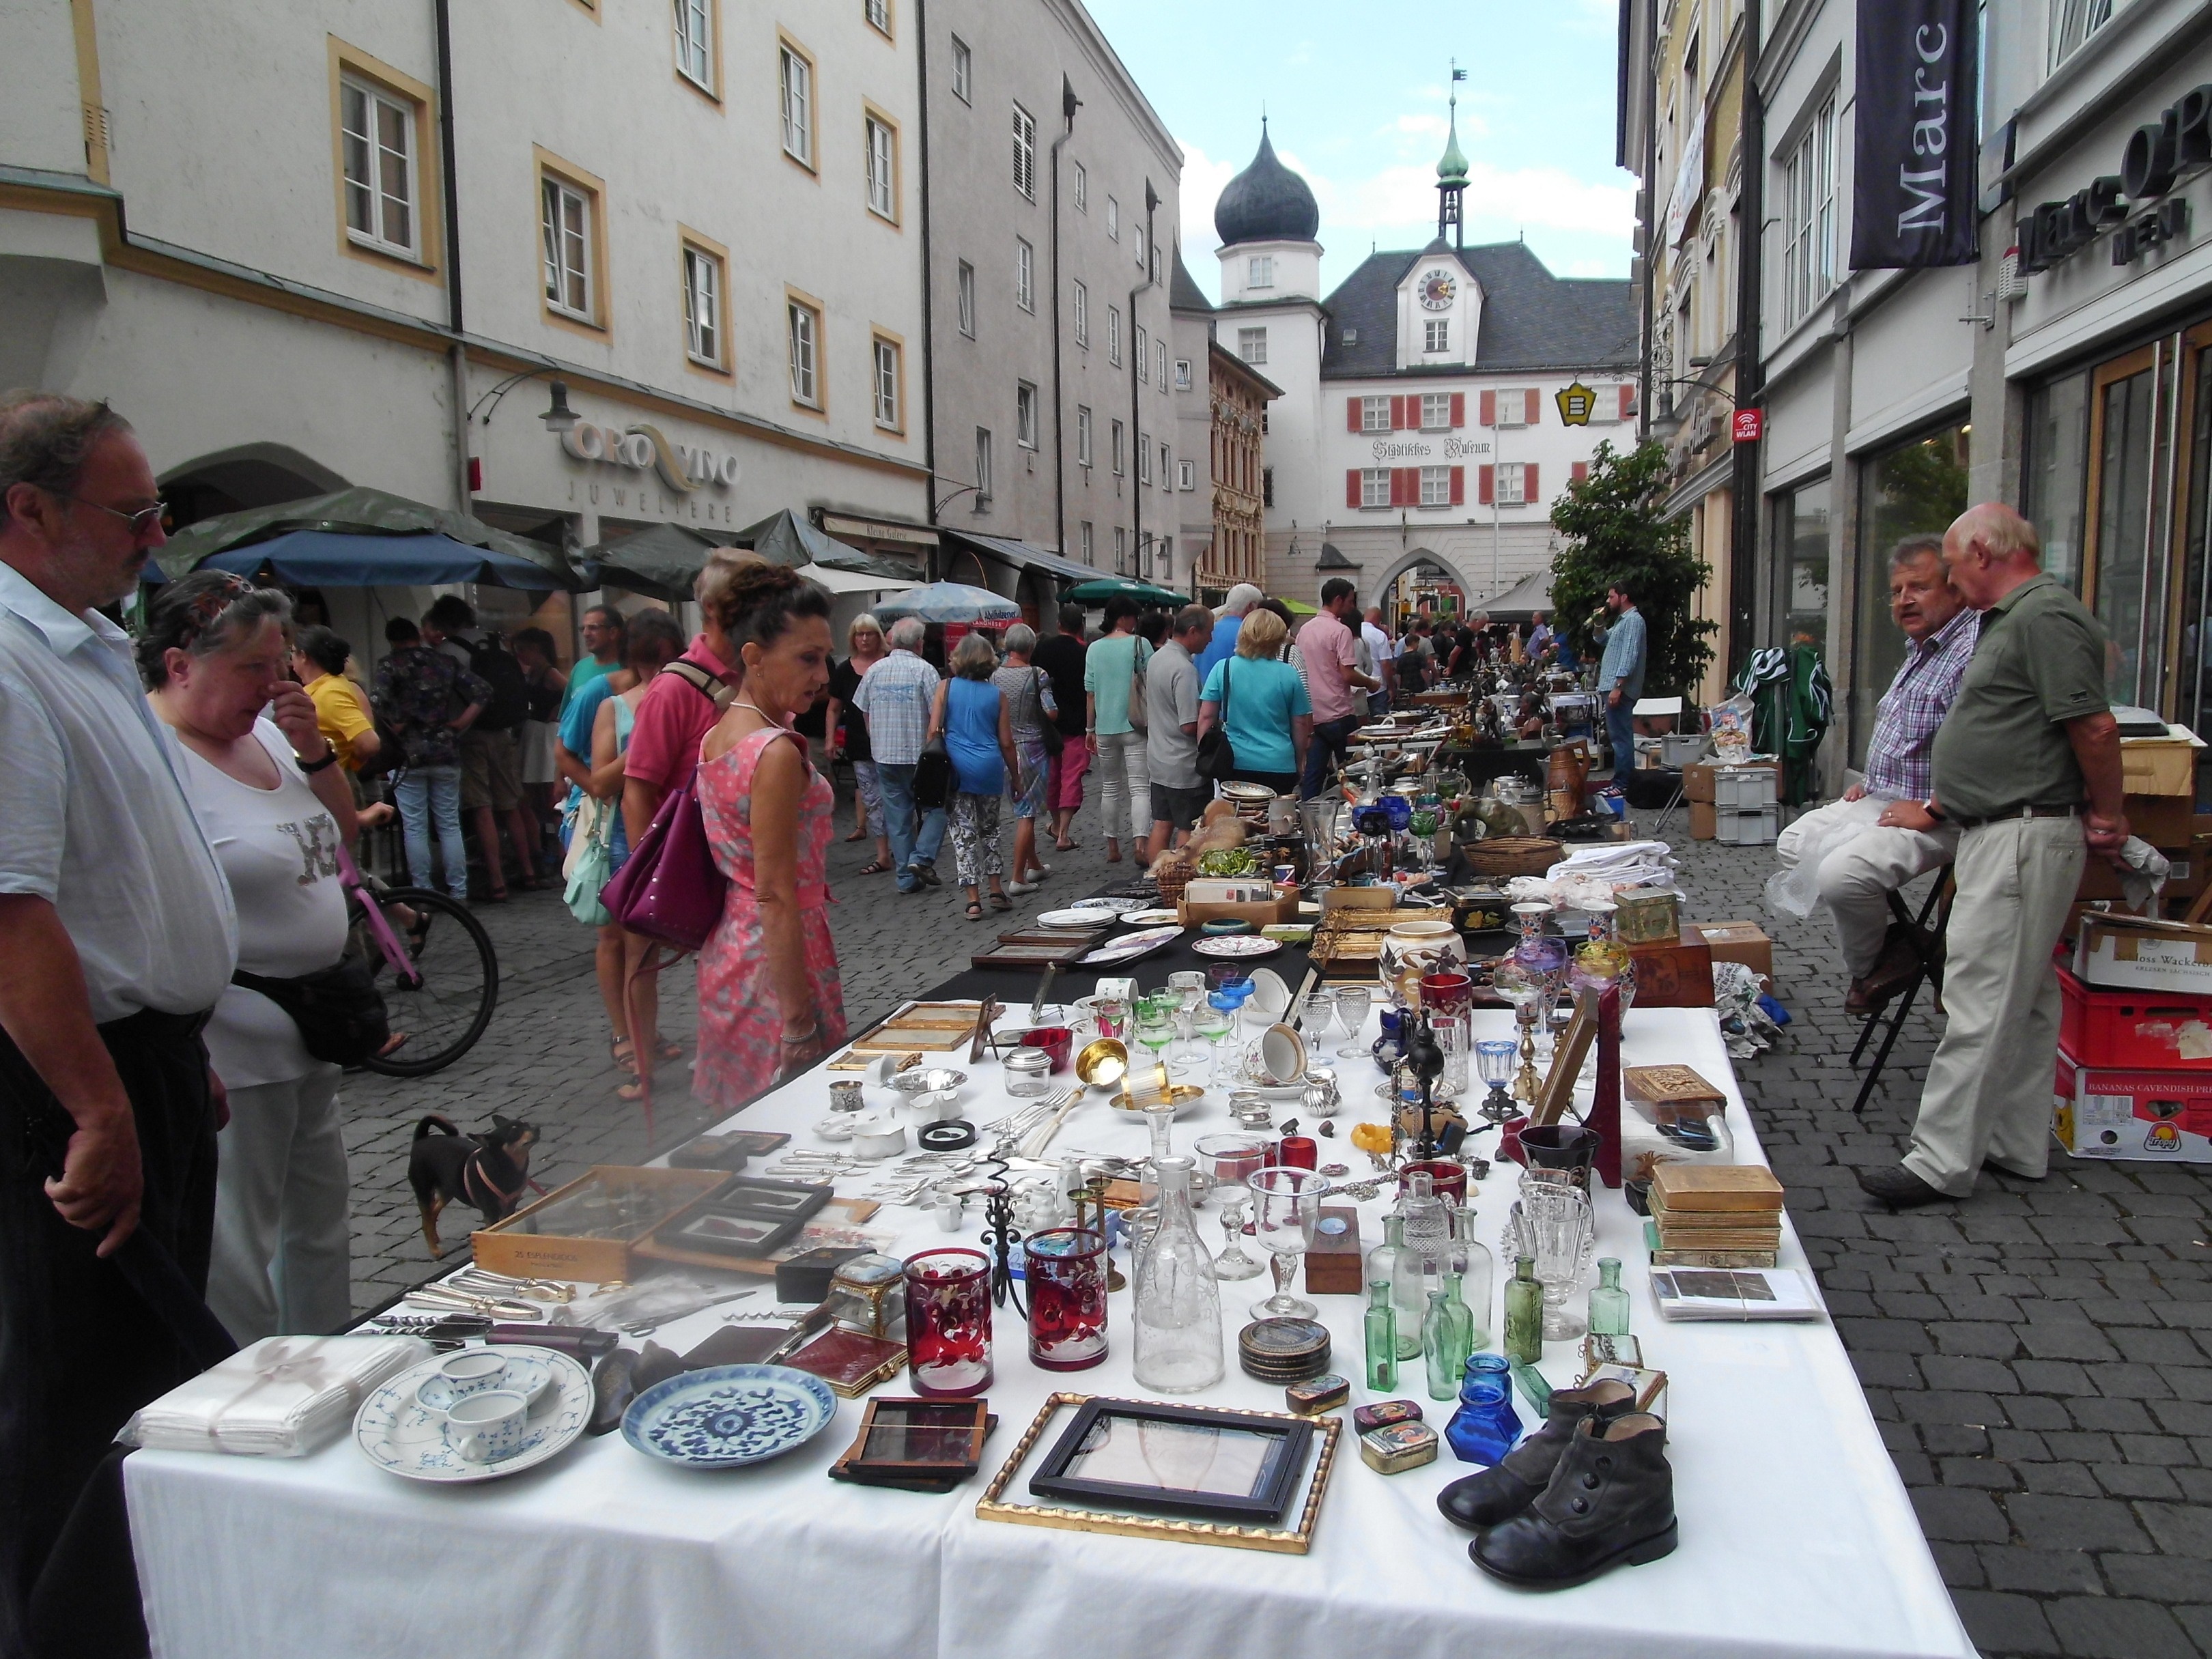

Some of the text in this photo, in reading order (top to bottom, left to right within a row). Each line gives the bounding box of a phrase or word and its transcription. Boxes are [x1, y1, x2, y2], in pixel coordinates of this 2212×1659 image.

[1897, 23, 1946, 238] Marc
[2121, 84, 2212, 199] O'P
[2112, 197, 2185, 266] MEN
[569, 421, 740, 486] ORO VIVO
[1372, 437, 1490, 463] Städtisches Museum
[568, 480, 731, 523] JUWELIERE
[2089, 1083, 2135, 1092] BANANAS
[2138, 1084, 2194, 1092] CAVENDISH
